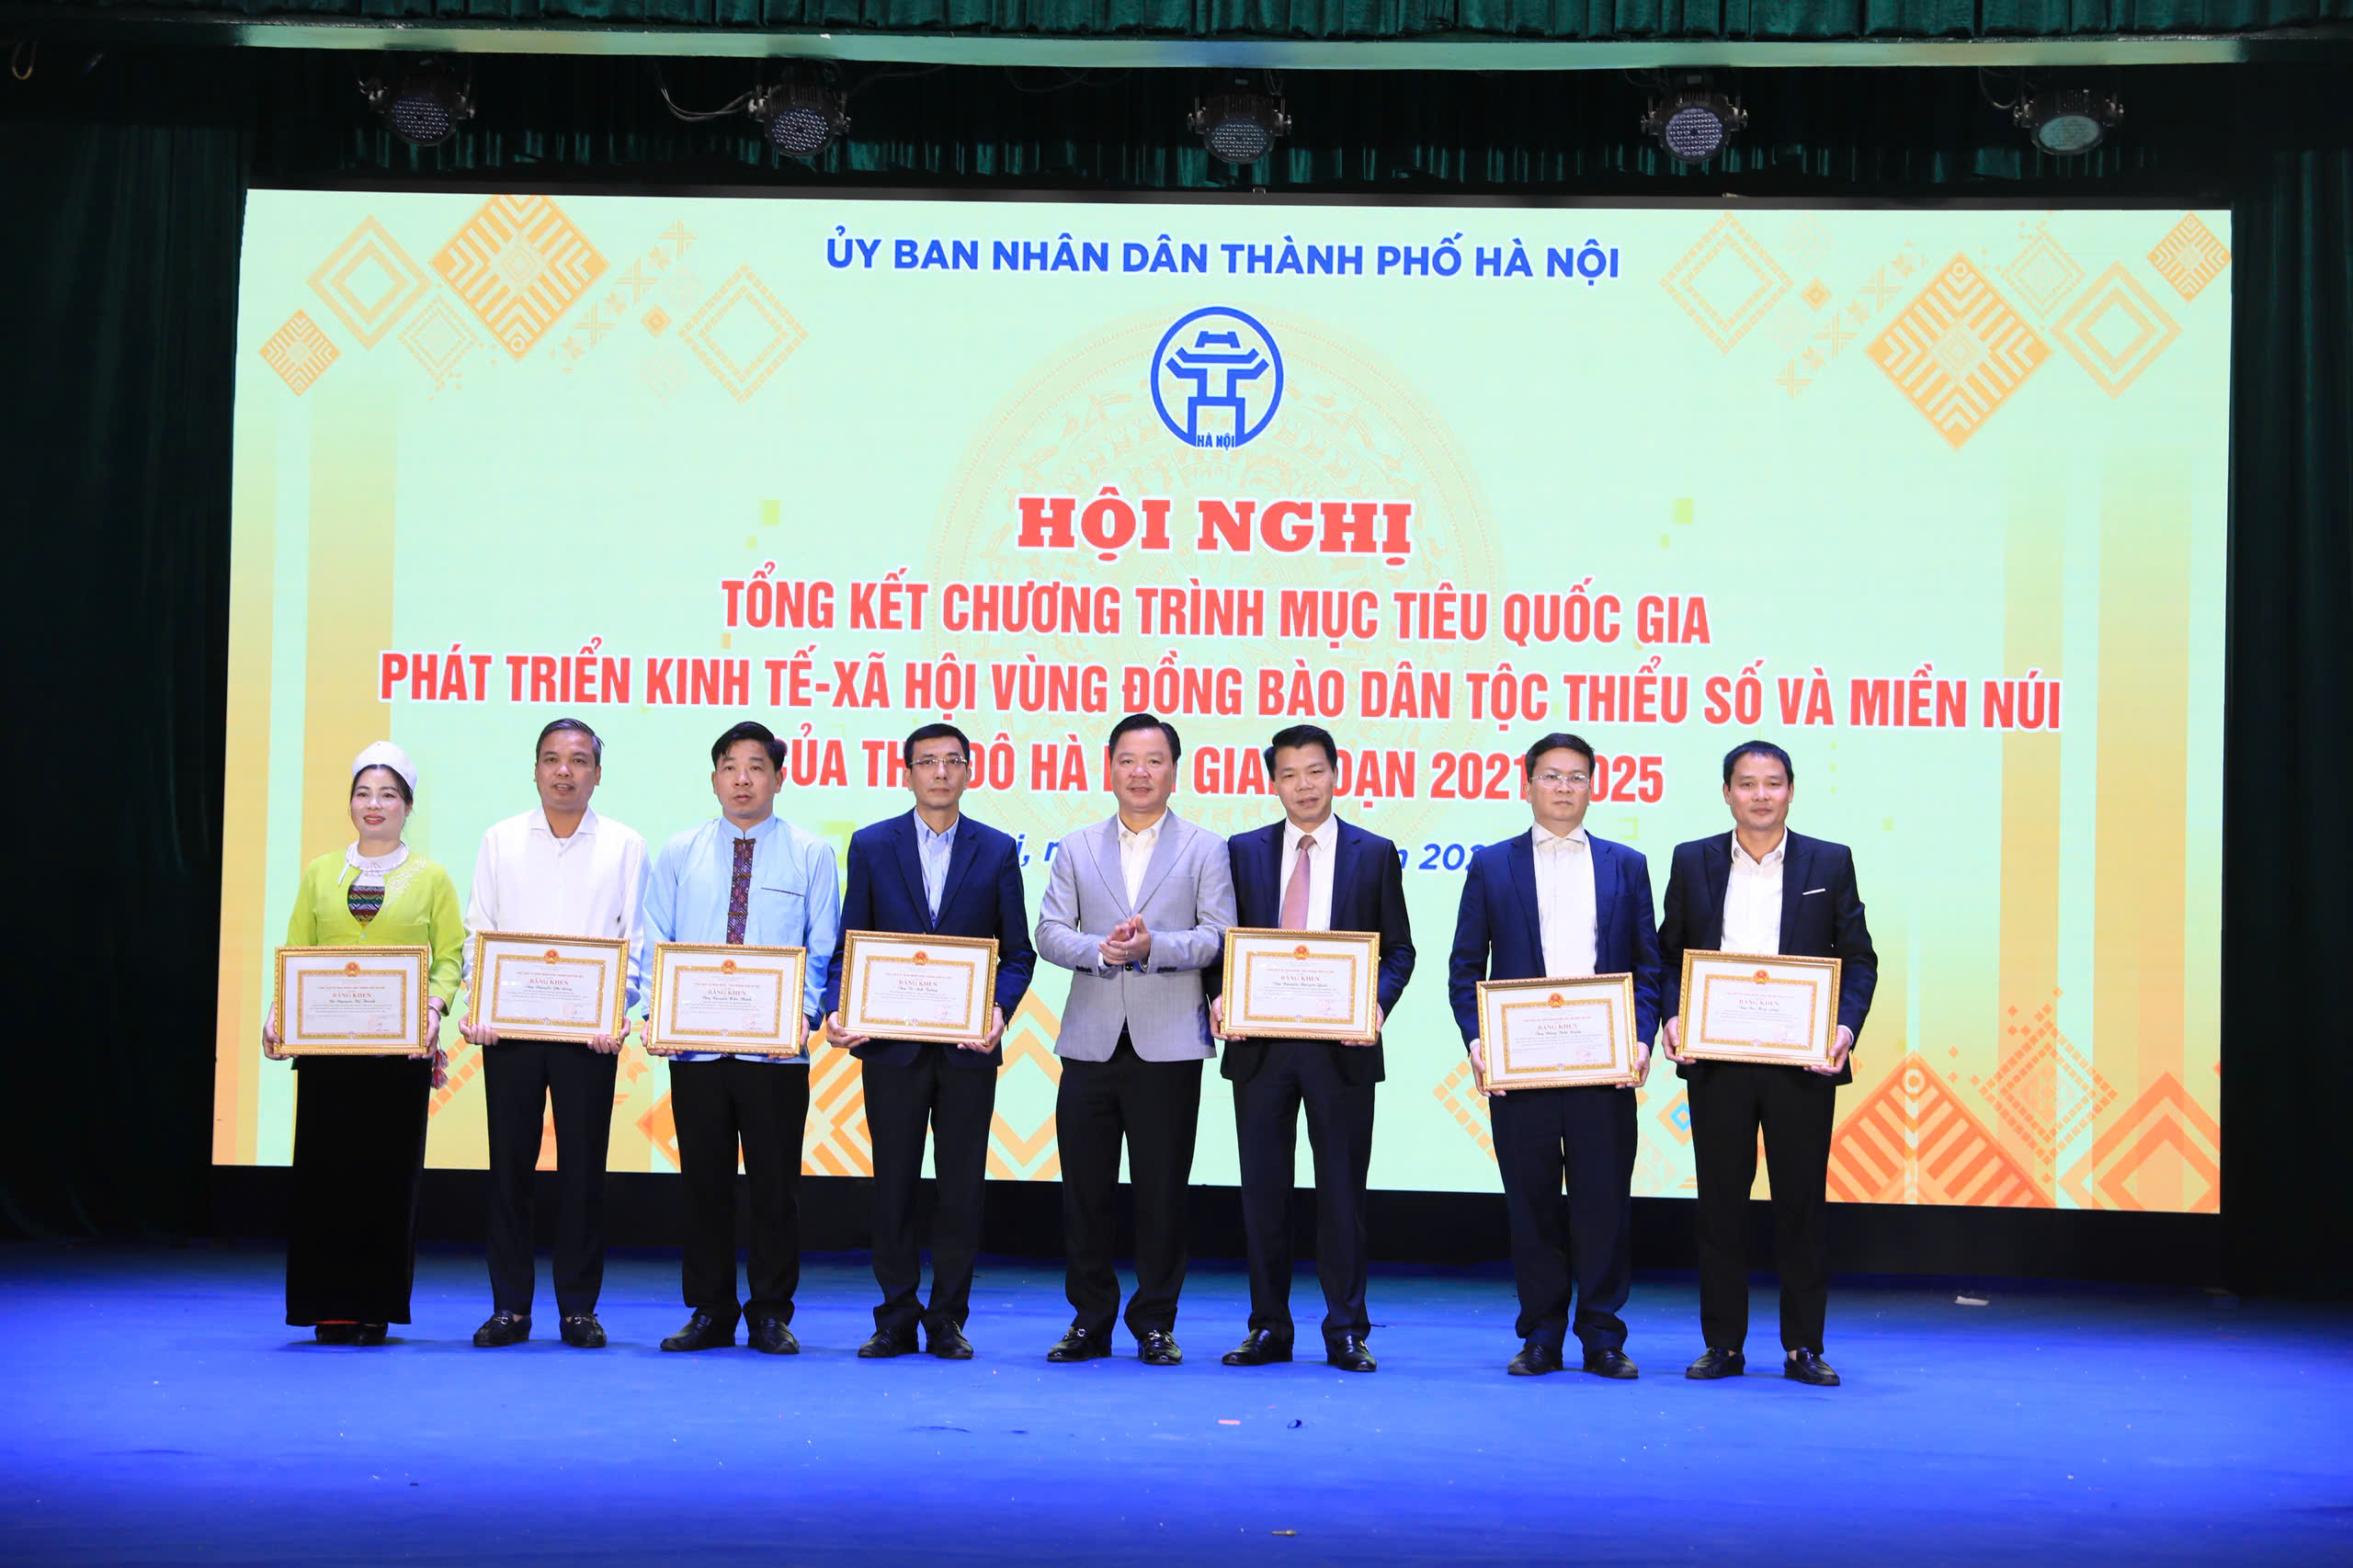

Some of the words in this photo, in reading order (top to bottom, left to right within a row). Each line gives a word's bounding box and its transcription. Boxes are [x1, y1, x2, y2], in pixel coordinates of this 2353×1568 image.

[826, 225, 882, 269] ỦY
[894, 239, 979, 270] BAN
[993, 233, 1109, 272] NHÂN
[1122, 233, 1208, 274] DÂN
[1221, 235, 1364, 276] THÀNH
[1376, 233, 1464, 278] PHỐ
[1476, 238, 1534, 278] HÀ
[1546, 239, 1619, 287] NỘI
[1197, 432, 1213, 448] HÀ
[1216, 432, 1234, 451] NỘI
[1017, 487, 1170, 562] HỘI
[1198, 500, 1412, 566] NGHỊ
[722, 562, 835, 629] TỔNG
[850, 567, 928, 631] KẾT
[943, 581, 1120, 634] CHƯƠNG
[1135, 578, 1264, 637] TRÌNH
[1280, 590, 1378, 649] MỤC
[1393, 583, 1487, 641] TIÊU
[1504, 577, 1620, 647] QUỐC
[1637, 596, 1711, 644] GIA
[381, 643, 492, 701] PHÁT
[506, 637, 631, 703] TRIỂN
[646, 658, 749, 706] KINH
[765, 645, 891, 709] TẾ-XÃ
[905, 653, 976, 721] HỘI
[992, 654, 1108, 713] VÙNG
[1122, 651, 1243, 716] ĐỒNG
[1258, 659, 1345, 718] BÀO
[1361, 662, 1451, 720] DÂN
[1466, 663, 1549, 732] TỘC
[1563, 655, 1688, 724] THIỂU
[1705, 659, 1764, 725] SỐ
[1779, 667, 1835, 725] VÀ
[1850, 664, 1967, 728] MIỀN
[1984, 671, 2060, 729] NÚI
[774, 722, 847, 787] ỦA
[862, 740, 908, 788] TH
[1031, 734, 1088, 791] HÀ
[1194, 746, 1279, 795] GIA
[1333, 749, 1415, 808] OẠN
